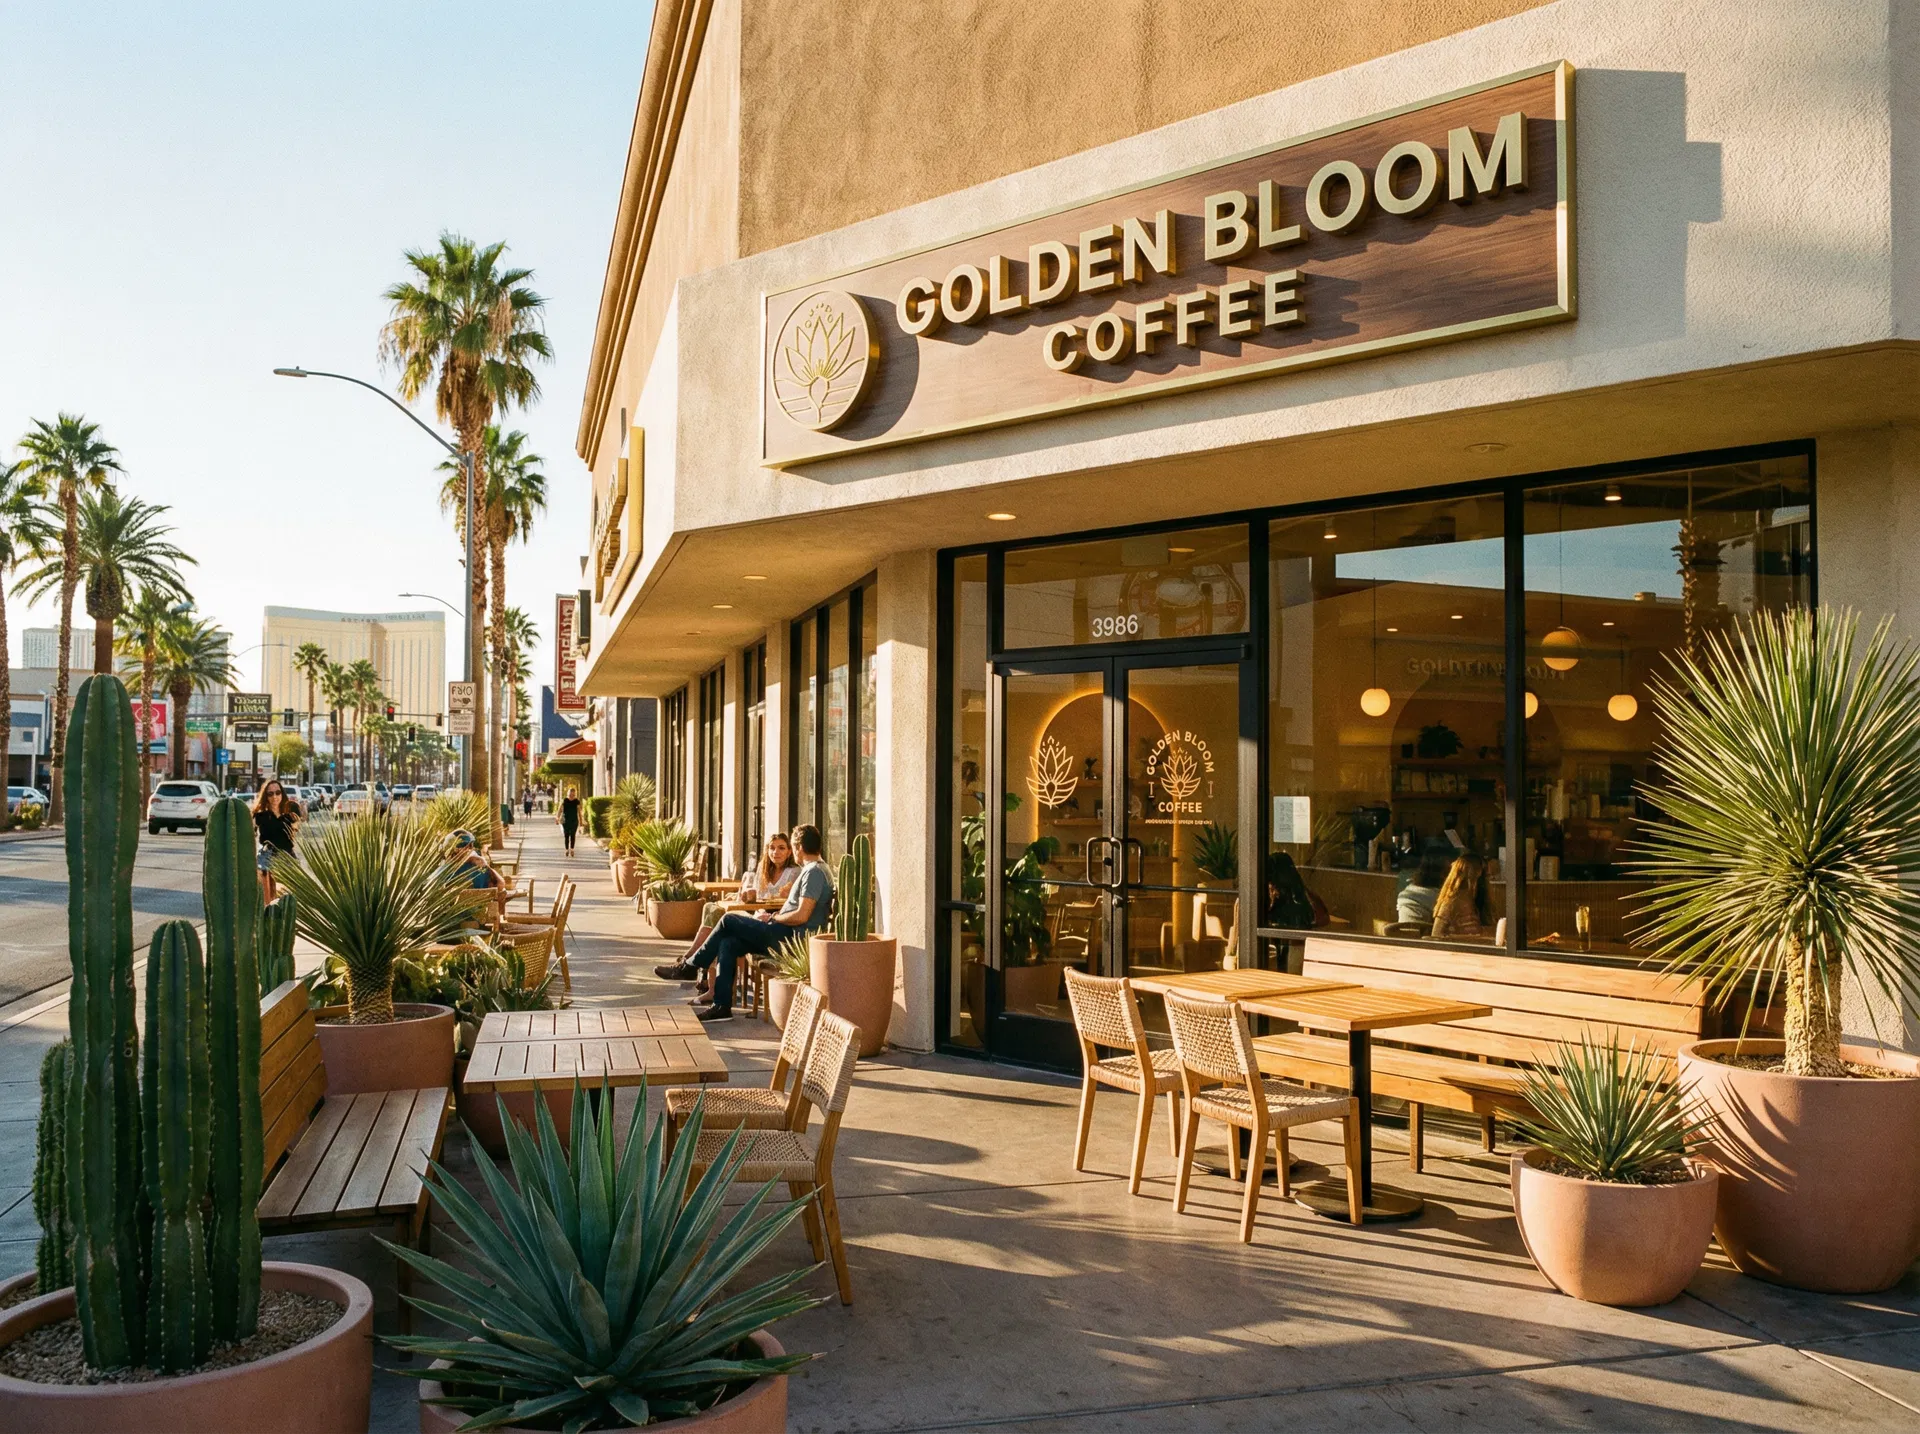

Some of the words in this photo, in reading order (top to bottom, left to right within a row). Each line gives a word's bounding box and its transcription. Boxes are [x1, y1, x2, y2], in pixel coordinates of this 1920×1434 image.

[896, 208, 1180, 337] GOLDEN
[1205, 112, 1526, 263] BLOOM
[1043, 270, 1306, 373] COFFEE
[1092, 614, 1138, 637] 3986
[1146, 729, 1181, 775] GOLDEN
[1184, 731, 1215, 773] BLOOM
[1158, 801, 1202, 813] COFFEE
